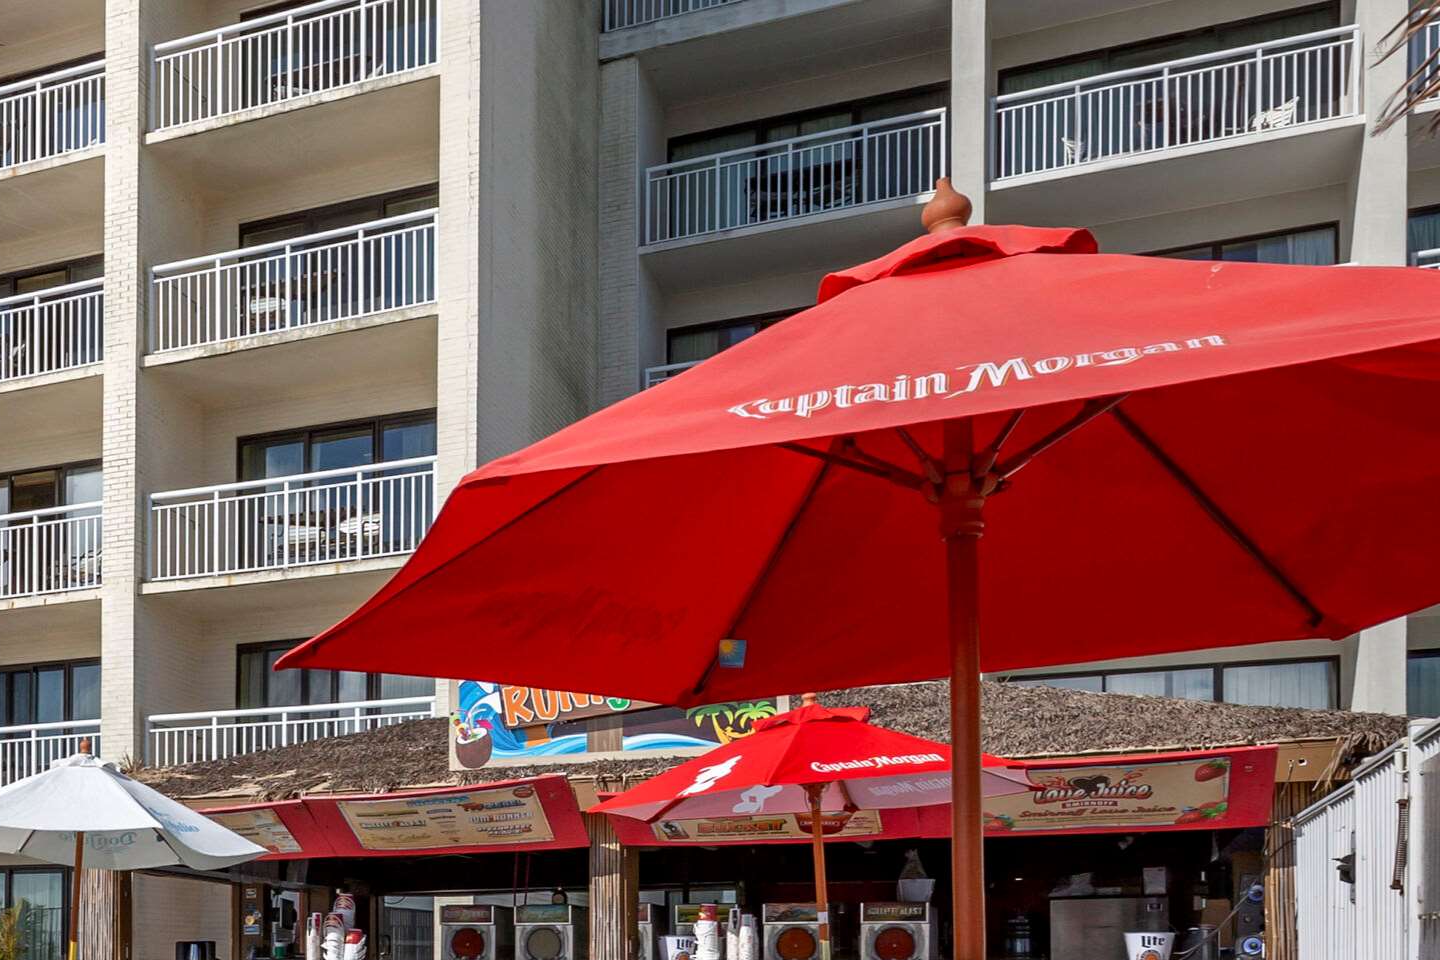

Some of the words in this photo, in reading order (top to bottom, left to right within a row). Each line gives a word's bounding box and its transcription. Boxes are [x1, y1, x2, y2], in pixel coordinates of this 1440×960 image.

[727, 374, 950, 418] Captain
[944, 334, 1227, 400] Morgan
[810, 761, 874, 773] Captain
[869, 753, 945, 768] Morgan
[1091, 779, 1153, 800] Juice
[1141, 935, 1165, 948] Lite
